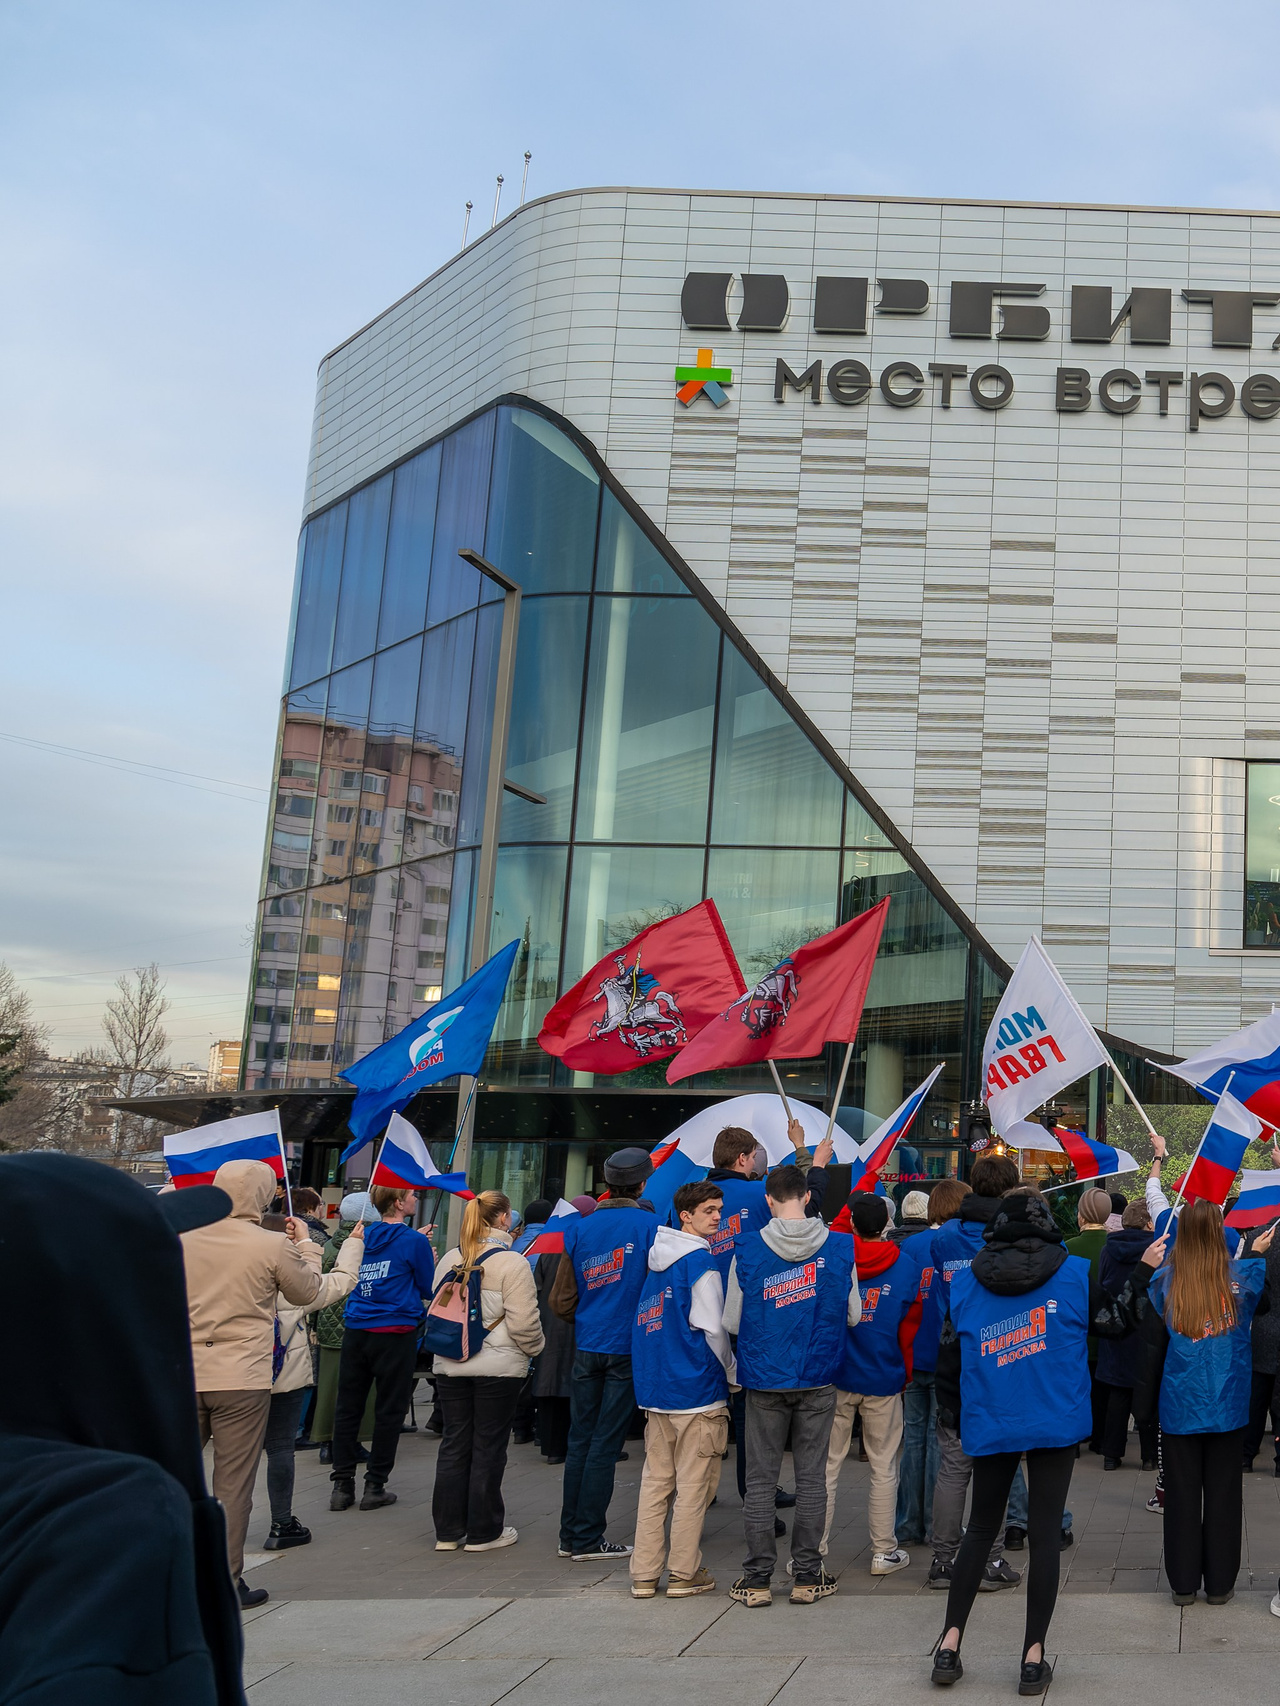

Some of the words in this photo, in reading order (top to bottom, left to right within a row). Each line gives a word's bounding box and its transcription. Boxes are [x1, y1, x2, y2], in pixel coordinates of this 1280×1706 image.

[774, 356, 1015, 410] место
[775, 1288, 816, 1309] МОСКВА
[997, 1340, 1046, 1367] МОСКВА
